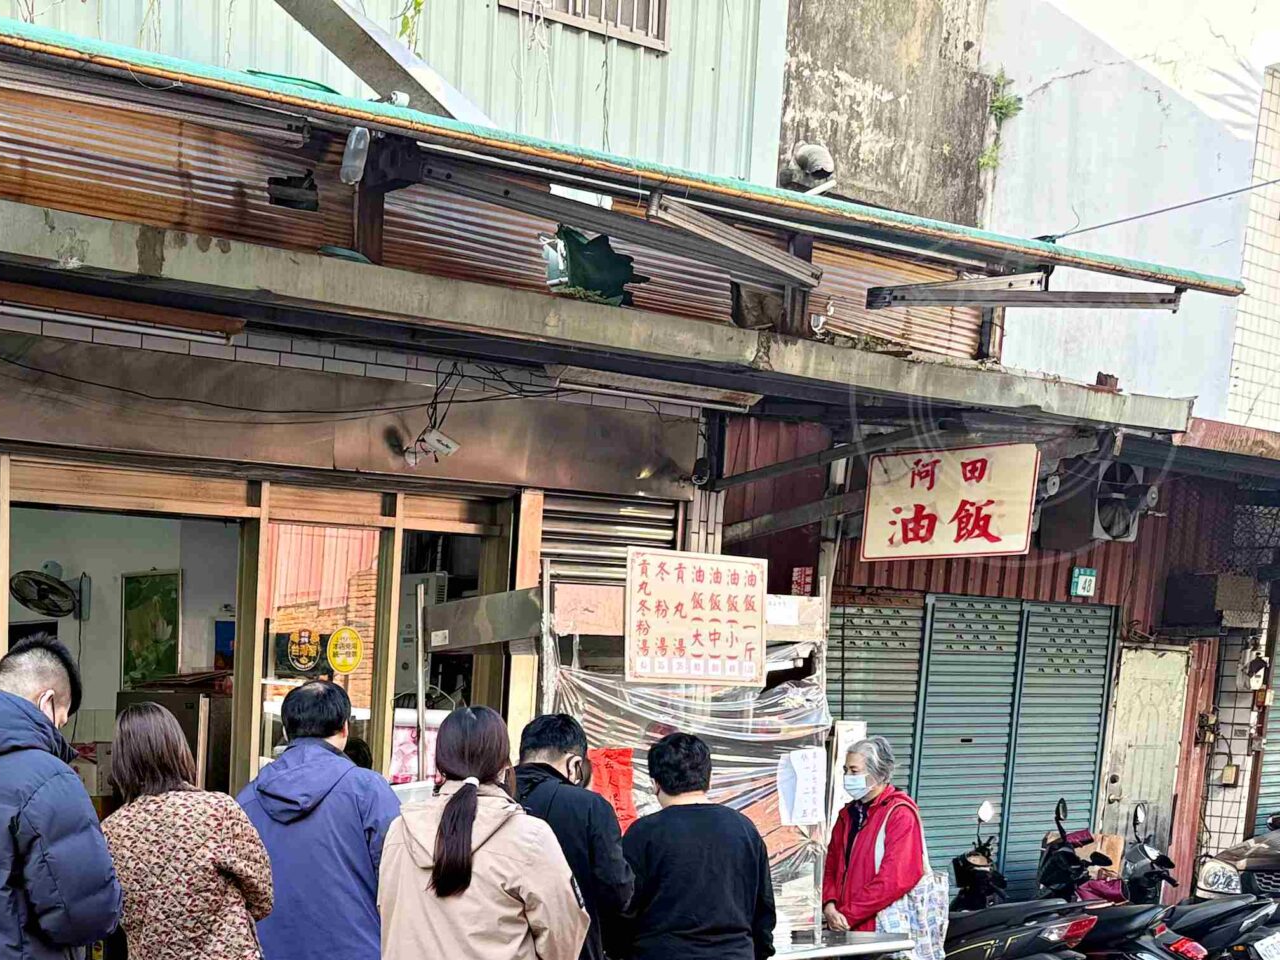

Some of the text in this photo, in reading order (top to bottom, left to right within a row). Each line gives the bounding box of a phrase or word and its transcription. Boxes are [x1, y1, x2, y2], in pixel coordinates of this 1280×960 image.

[910, 457, 988, 491] 阿田
[888, 499, 1002, 545] 油飯
[636, 560, 651, 657] 貢丸冬粉湯
[655, 561, 670, 657] 冬粉湯
[673, 563, 687, 657] 貢丸湯
[742, 570, 757, 661] 油飯一斤
